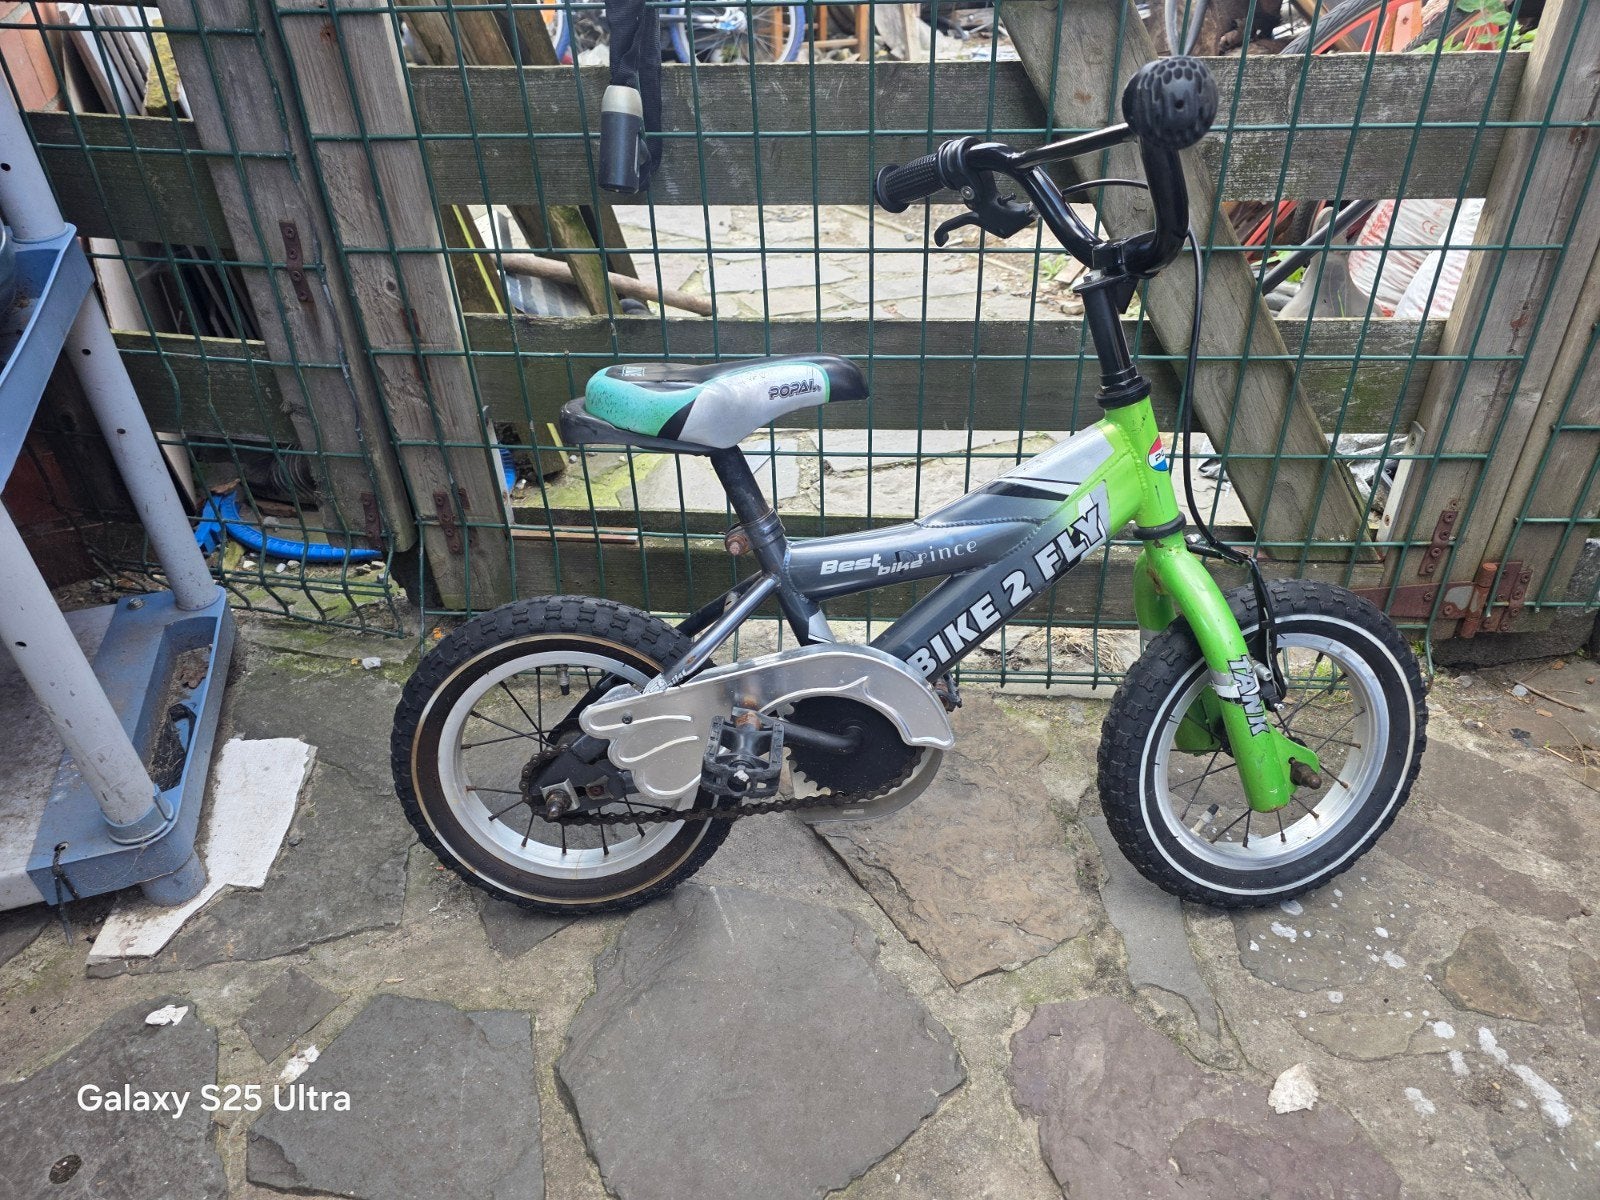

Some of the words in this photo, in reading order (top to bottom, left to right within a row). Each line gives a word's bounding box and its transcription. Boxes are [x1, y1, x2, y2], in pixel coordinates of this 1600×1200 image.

[820, 553, 881, 576] Best
[877, 556, 923, 577] bike
[904, 593, 1002, 680] BIKE
[1000, 569, 1033, 608] 2
[1032, 502, 1104, 582] FLY
[1227, 654, 1271, 737] TANK
